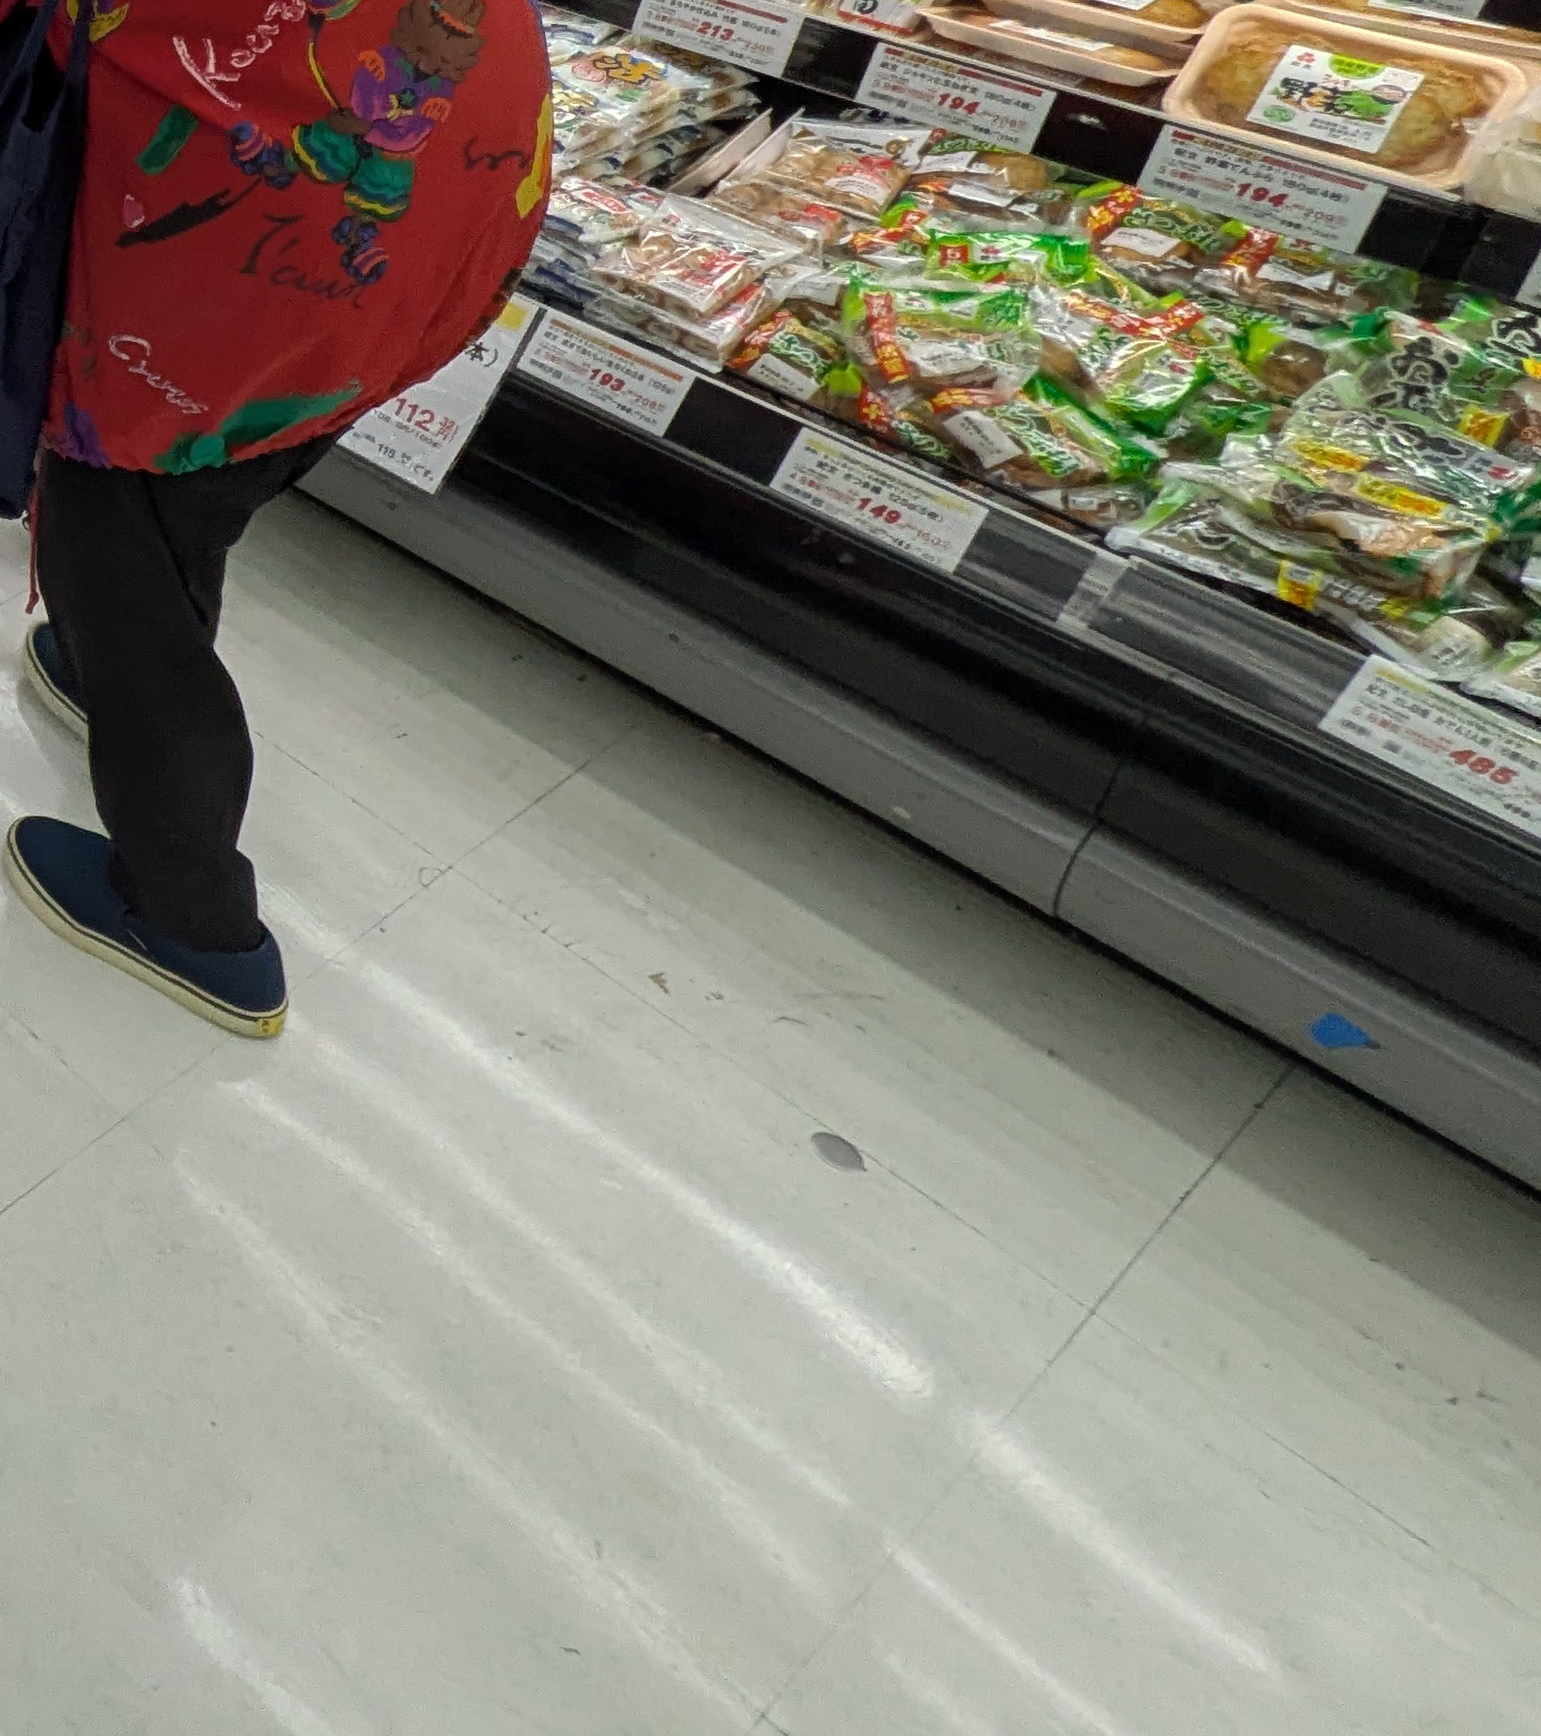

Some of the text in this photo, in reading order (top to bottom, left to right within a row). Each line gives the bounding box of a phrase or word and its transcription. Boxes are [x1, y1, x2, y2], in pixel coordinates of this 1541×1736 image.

[697, 22, 734, 41] 213
[938, 93, 979, 115] 194
[1237, 183, 1286, 207] 194
[590, 369, 625, 392] 193
[394, 396, 436, 430] 112
[857, 498, 901, 524] 149
[1449, 749, 1515, 784] 485
